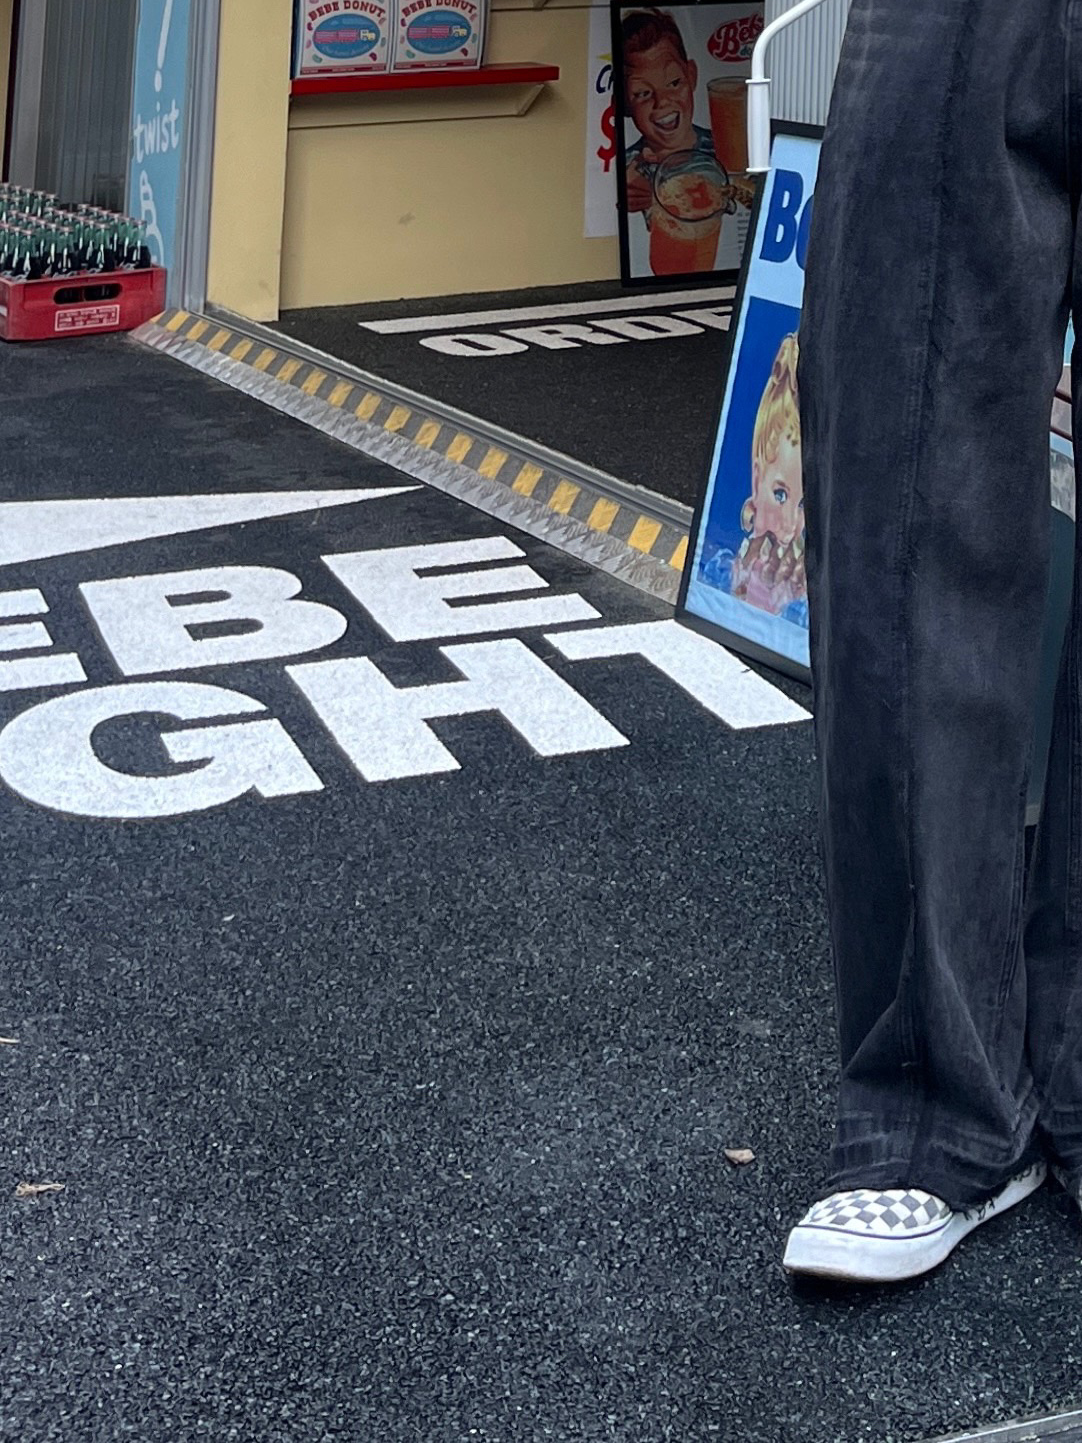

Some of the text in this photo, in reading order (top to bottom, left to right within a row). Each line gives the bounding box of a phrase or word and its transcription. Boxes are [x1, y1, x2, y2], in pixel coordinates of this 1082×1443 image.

[308, 0, 386, 22] BEBE DONUT
[133, 99, 180, 163] twist
